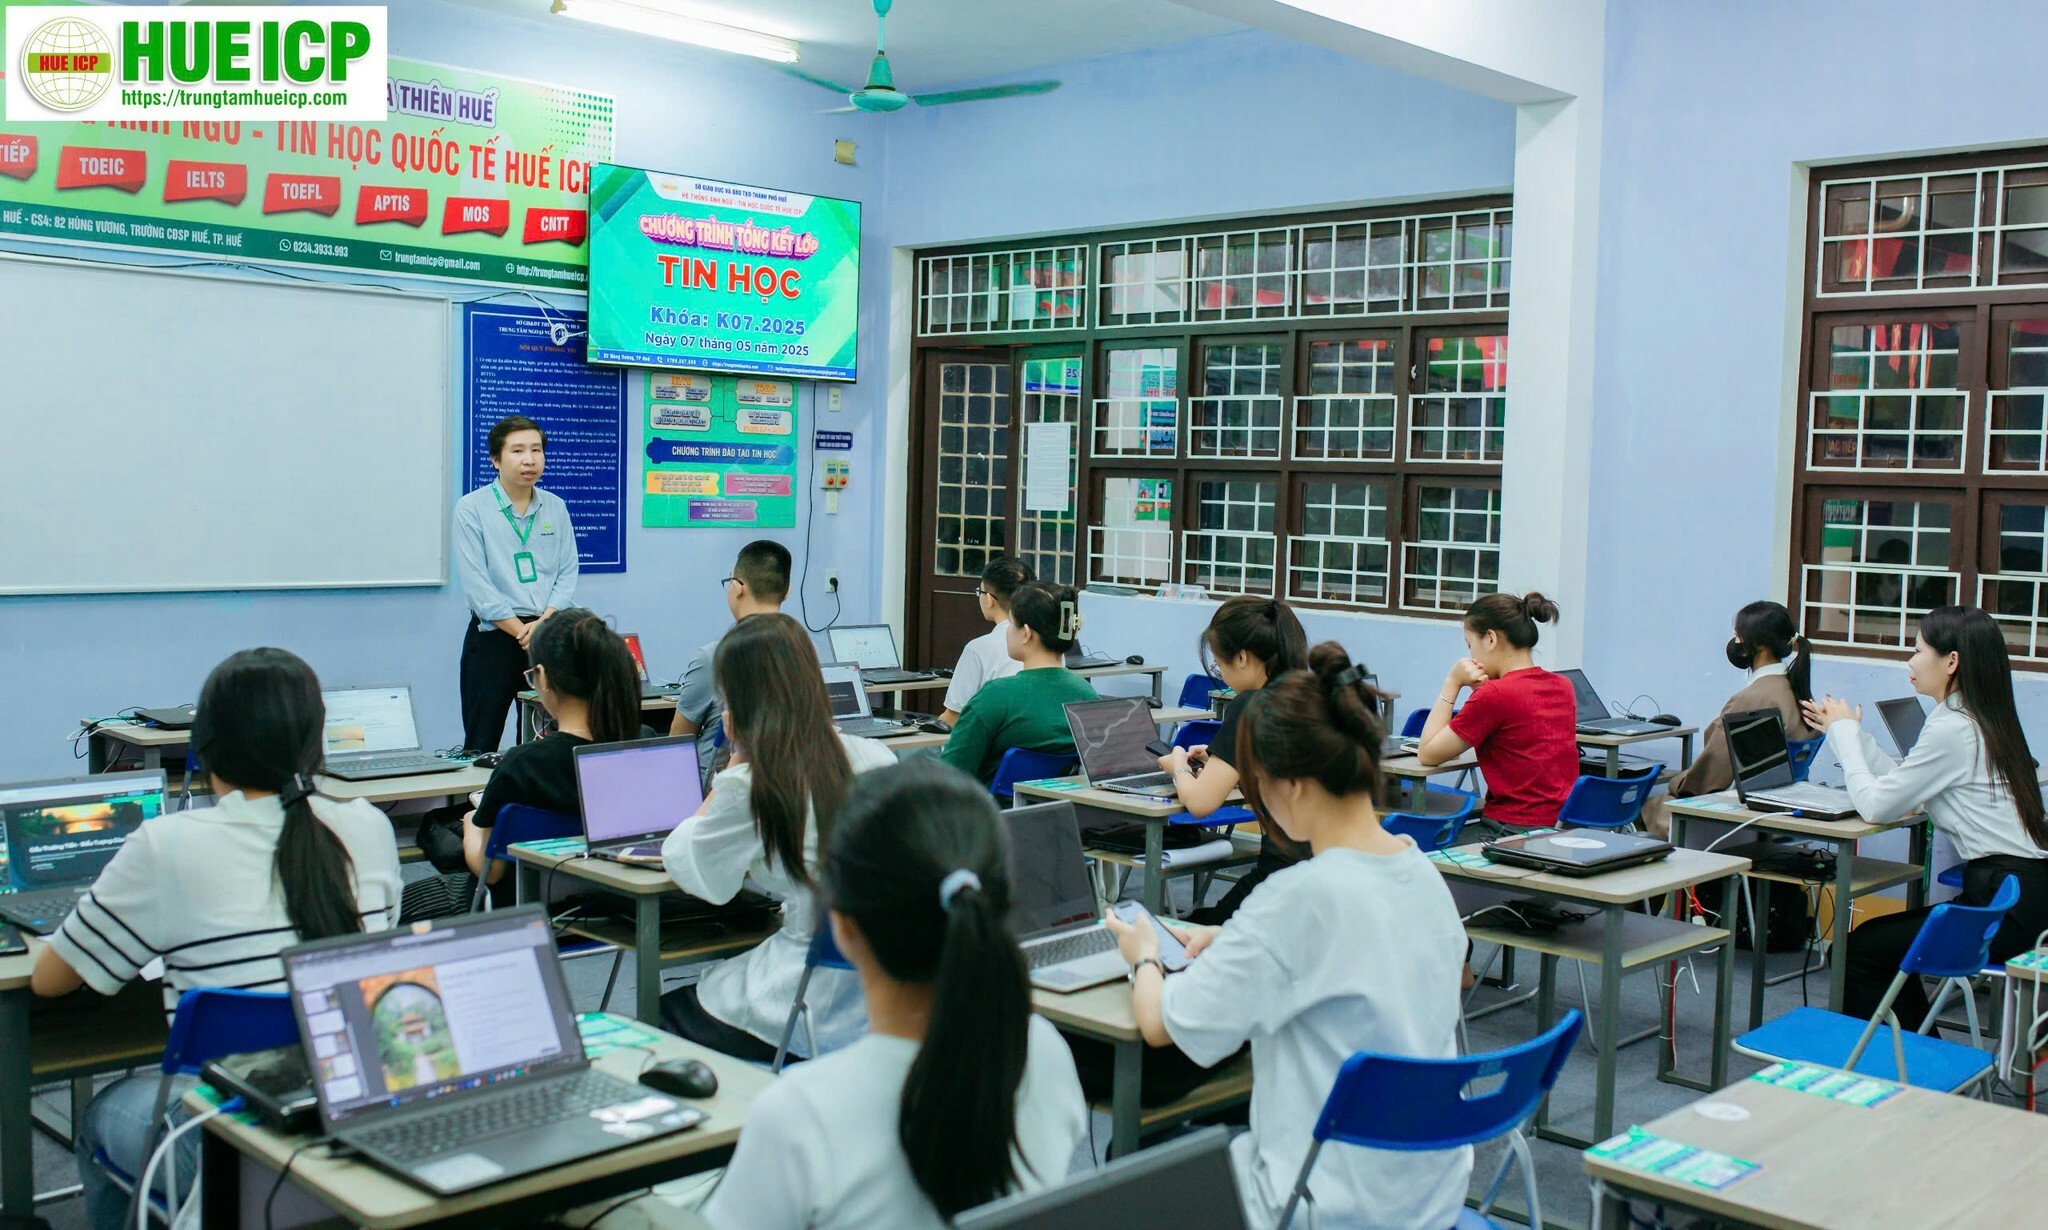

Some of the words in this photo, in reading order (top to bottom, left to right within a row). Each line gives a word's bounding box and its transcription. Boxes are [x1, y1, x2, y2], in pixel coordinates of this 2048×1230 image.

[400, 85, 452, 116] THIÊN
[459, 92, 495, 122] HUẾ
[278, 121, 317, 156] TIN
[328, 123, 382, 170] HỌC
[392, 126, 460, 177] QUỐC
[469, 136, 500, 181] TẾ
[505, 144, 554, 189] HUẾ
[79, 157, 125, 176] TOEIC
[186, 170, 225, 189] IELTS
[282, 182, 322, 200] TOEFL
[374, 195, 410, 212] APTIS
[463, 206, 490, 223] MOS
[540, 216, 570, 232] CNTT
[3, 208, 23, 224] HUẾ
[30, 213, 52, 227] CS4:
[54, 216, 66, 229] 82
[68, 216, 93, 231] HÙNG
[95, 220, 128, 236] VƯƠNG,
[130, 223, 165, 239] TRƯỜNG
[167, 227, 190, 241] CĐSP
[191, 229, 211, 245] HUẾ,
[212, 233, 224, 245] TP.
[226, 232, 243, 247] HUẾ
[639, 214, 696, 243] CHƯƠNG
[695, 216, 734, 247] TRÌNH
[736, 218, 770, 252] TỔNG
[771, 226, 795, 254] KẾT
[795, 233, 819, 257] LỚP
[293, 240, 349, 258] 0234.3933.993
[395, 252, 481, 271] trungtamicp@gmail.com
[657, 255, 717, 291] TIN
[728, 263, 801, 303] HỌC
[650, 306, 709, 328] Khóa:
[716, 312, 806, 336] K07.2025
[645, 332, 677, 348] Ngày
[680, 336, 695, 348] 07
[699, 336, 733, 352] tháng
[736, 340, 751, 352] 05
[754, 341, 778, 355] năm
[781, 344, 809, 357] 2025
[672, 446, 700, 457] CHƯƠNG
[701, 446, 721, 457] TRÌNH
[722, 447, 736, 458] ĐÀO
[737, 448, 750, 459] TẠO
[751, 449, 762, 458] TIN
[763, 449, 777, 459] HỌC
